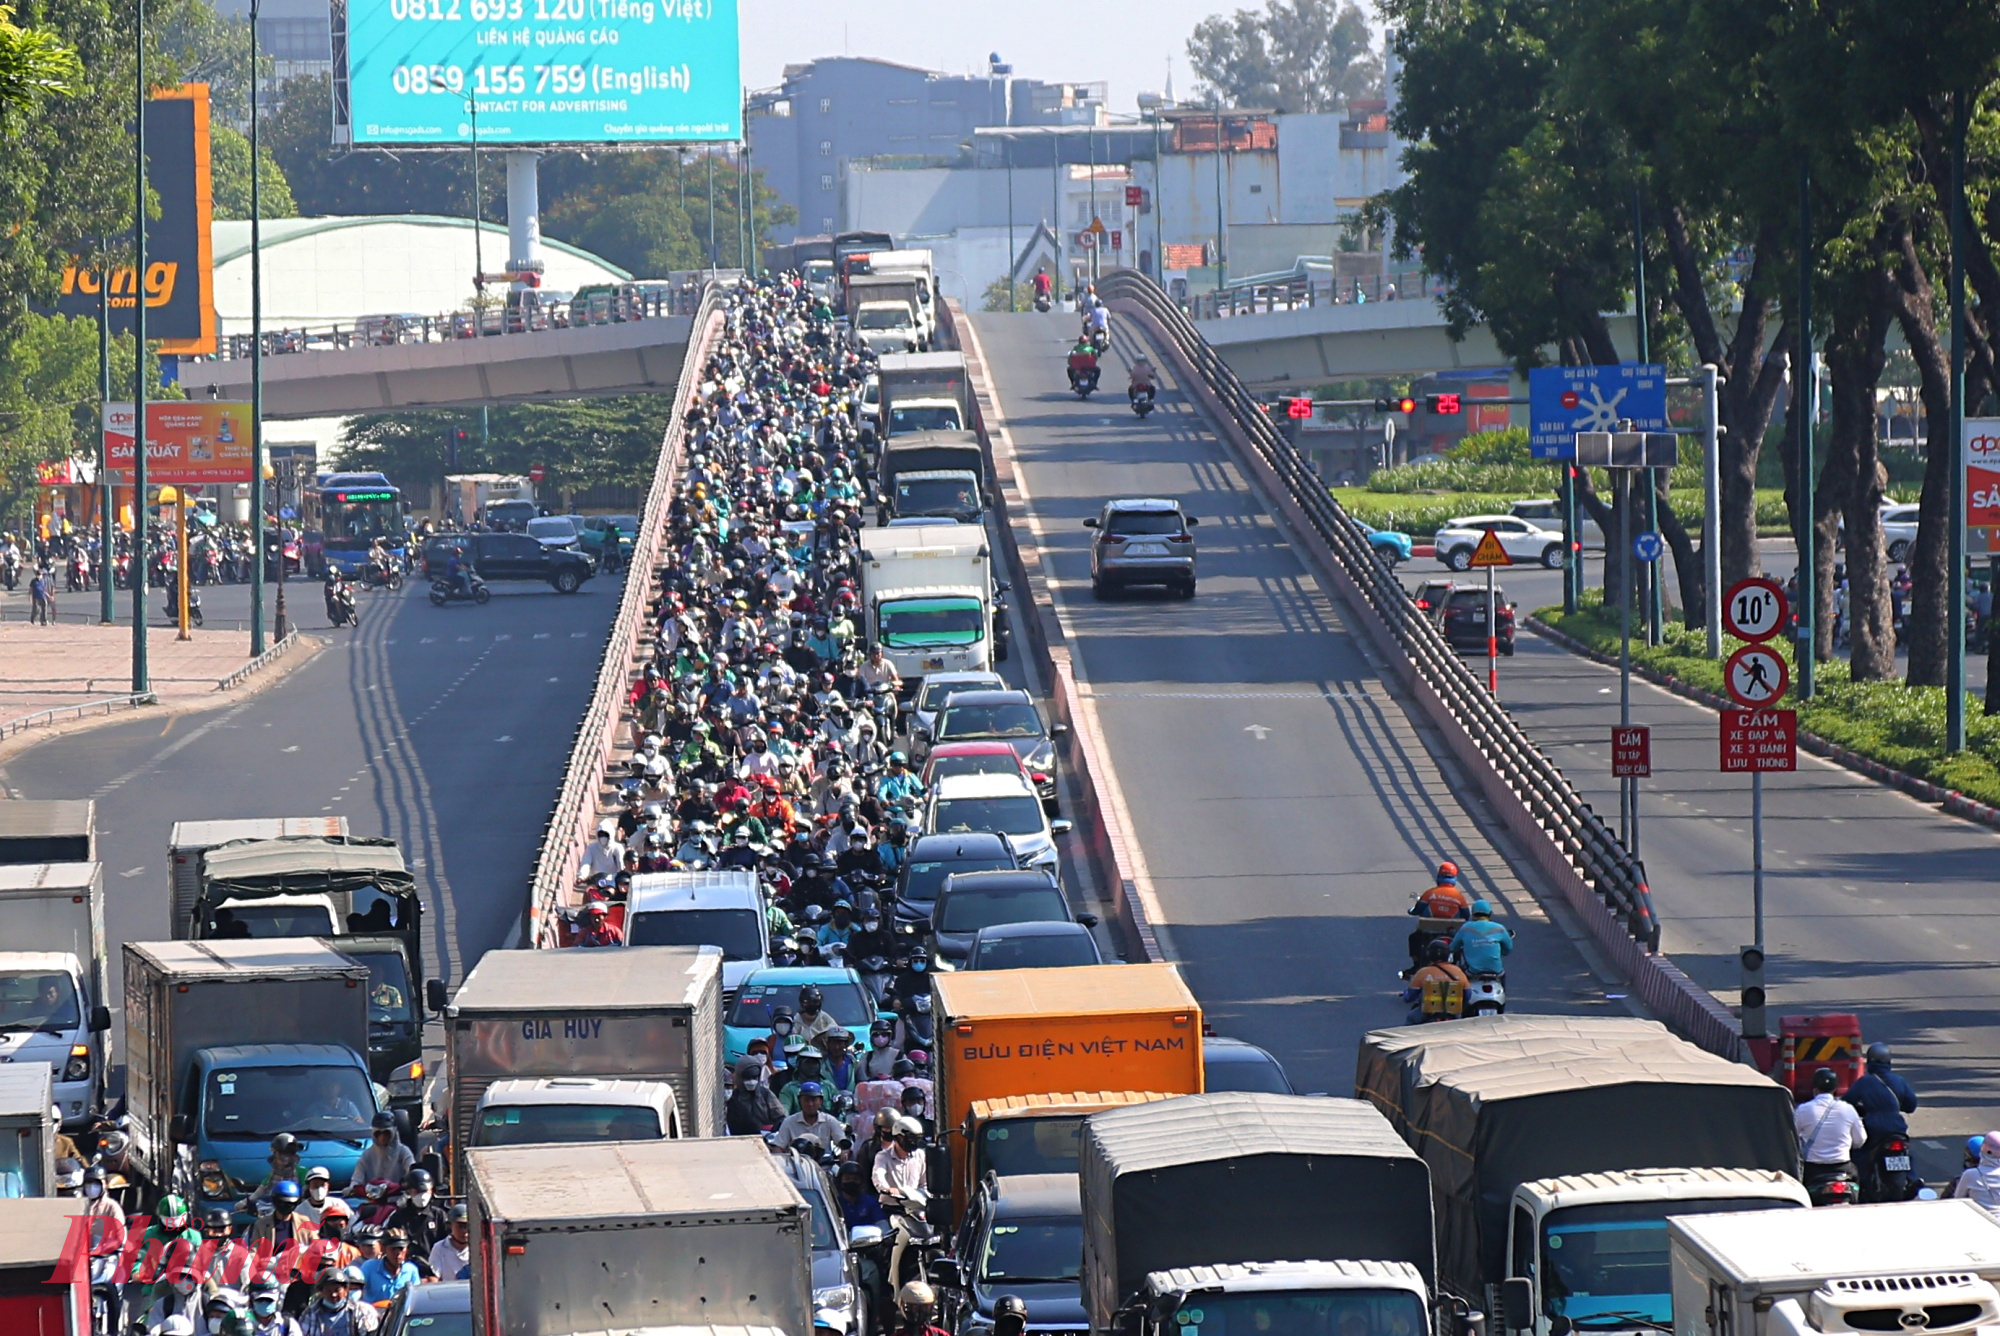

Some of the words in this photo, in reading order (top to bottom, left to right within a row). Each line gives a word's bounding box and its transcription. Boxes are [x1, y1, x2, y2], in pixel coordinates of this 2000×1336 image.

[390, 0, 462, 21] 0812
[470, 0, 524, 21] 693
[533, 0, 585, 21] 120
[476, 27, 508, 45] LIÊN
[512, 27, 531, 47] HỆ
[535, 26, 586, 47] QUẢNG
[589, 26, 619, 44] CÁO
[393, 64, 464, 94] 0859
[474, 64, 526, 94] 155
[534, 64, 587, 94] 759
[592, 63, 690, 94] (English)
[464, 100, 518, 113] CONTACT
[522, 101, 546, 113] FOR
[550, 100, 628, 112] ADVERTISING
[1288, 398, 1311, 418] 25
[1437, 394, 1459, 414] 25
[1738, 709, 1778, 727] CẤM
[1619, 729, 1641, 746] CẤM
[1730, 731, 1743, 740] XE
[1748, 730, 1768, 743] ĐẠP
[1774, 728, 1786, 740] VÀ
[1730, 745, 1743, 754] XE
[1749, 745, 1755, 754] 3
[1760, 743, 1786, 754] BÁNH
[1756, 756, 1788, 768] THÔNG
[522, 1020, 553, 1040] GIA
[564, 1019, 602, 1039] HUY
[963, 1044, 1011, 1060] BƯU
[1018, 1039, 1074, 1060] ĐIỆN
[1080, 1036, 1128, 1058] VIỆT
[1134, 1037, 1184, 1053] NAM
